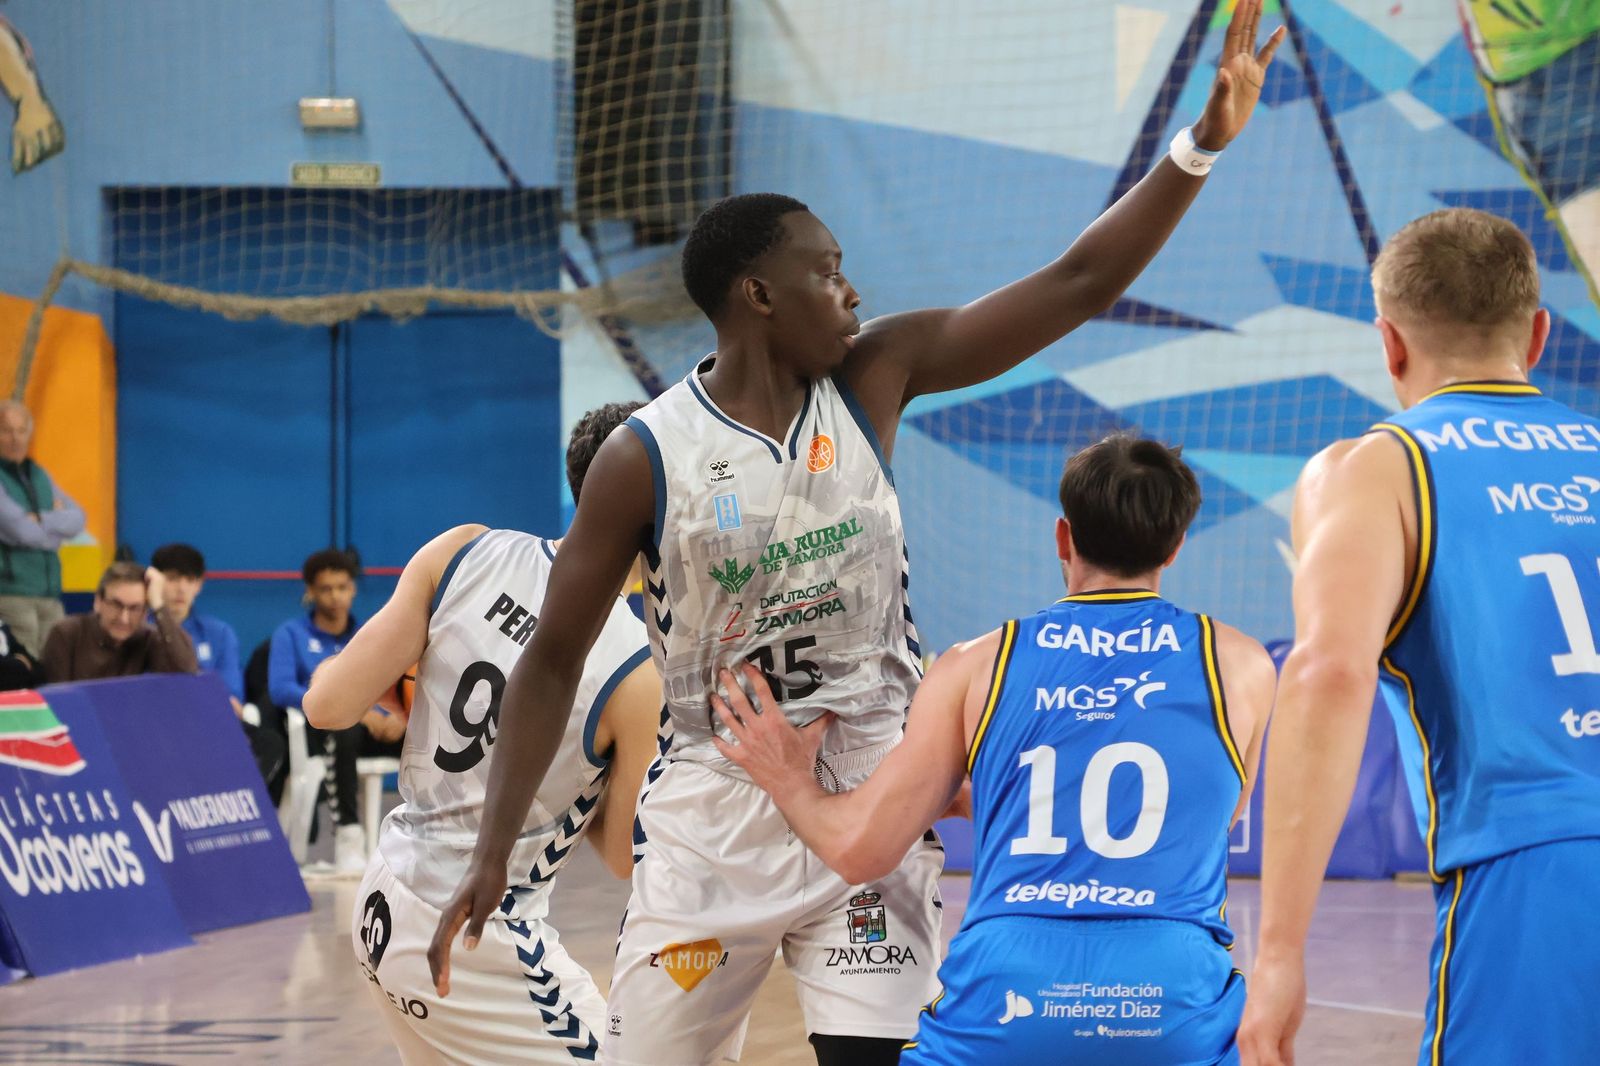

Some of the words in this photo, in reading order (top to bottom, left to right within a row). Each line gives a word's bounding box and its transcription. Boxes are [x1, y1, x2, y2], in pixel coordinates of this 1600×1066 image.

[1487, 483, 1589, 514] MGS
[794, 517, 864, 551] RURAL
[1551, 512, 1596, 526] Seguros
[762, 560, 783, 575] DE
[787, 542, 846, 567] ZAMORA
[755, 597, 847, 635] ZAMORA
[1036, 618, 1181, 657] GARCÍA
[745, 635, 824, 701] 15
[1034, 684, 1118, 711] MGS
[433, 661, 507, 773] 9
[1076, 711, 1116, 722] Seguros
[1009, 741, 1169, 859] 10
[1004, 879, 1156, 909] telepizza
[649, 951, 729, 970] ZAMORA
[823, 945, 918, 967] ZAMORA
[840, 967, 901, 976] AYUNTAMIENTO
[1082, 983, 1163, 998] Fundación
[1041, 1001, 1116, 1018] Jiménez
[1121, 1001, 1162, 1018] Díaz
